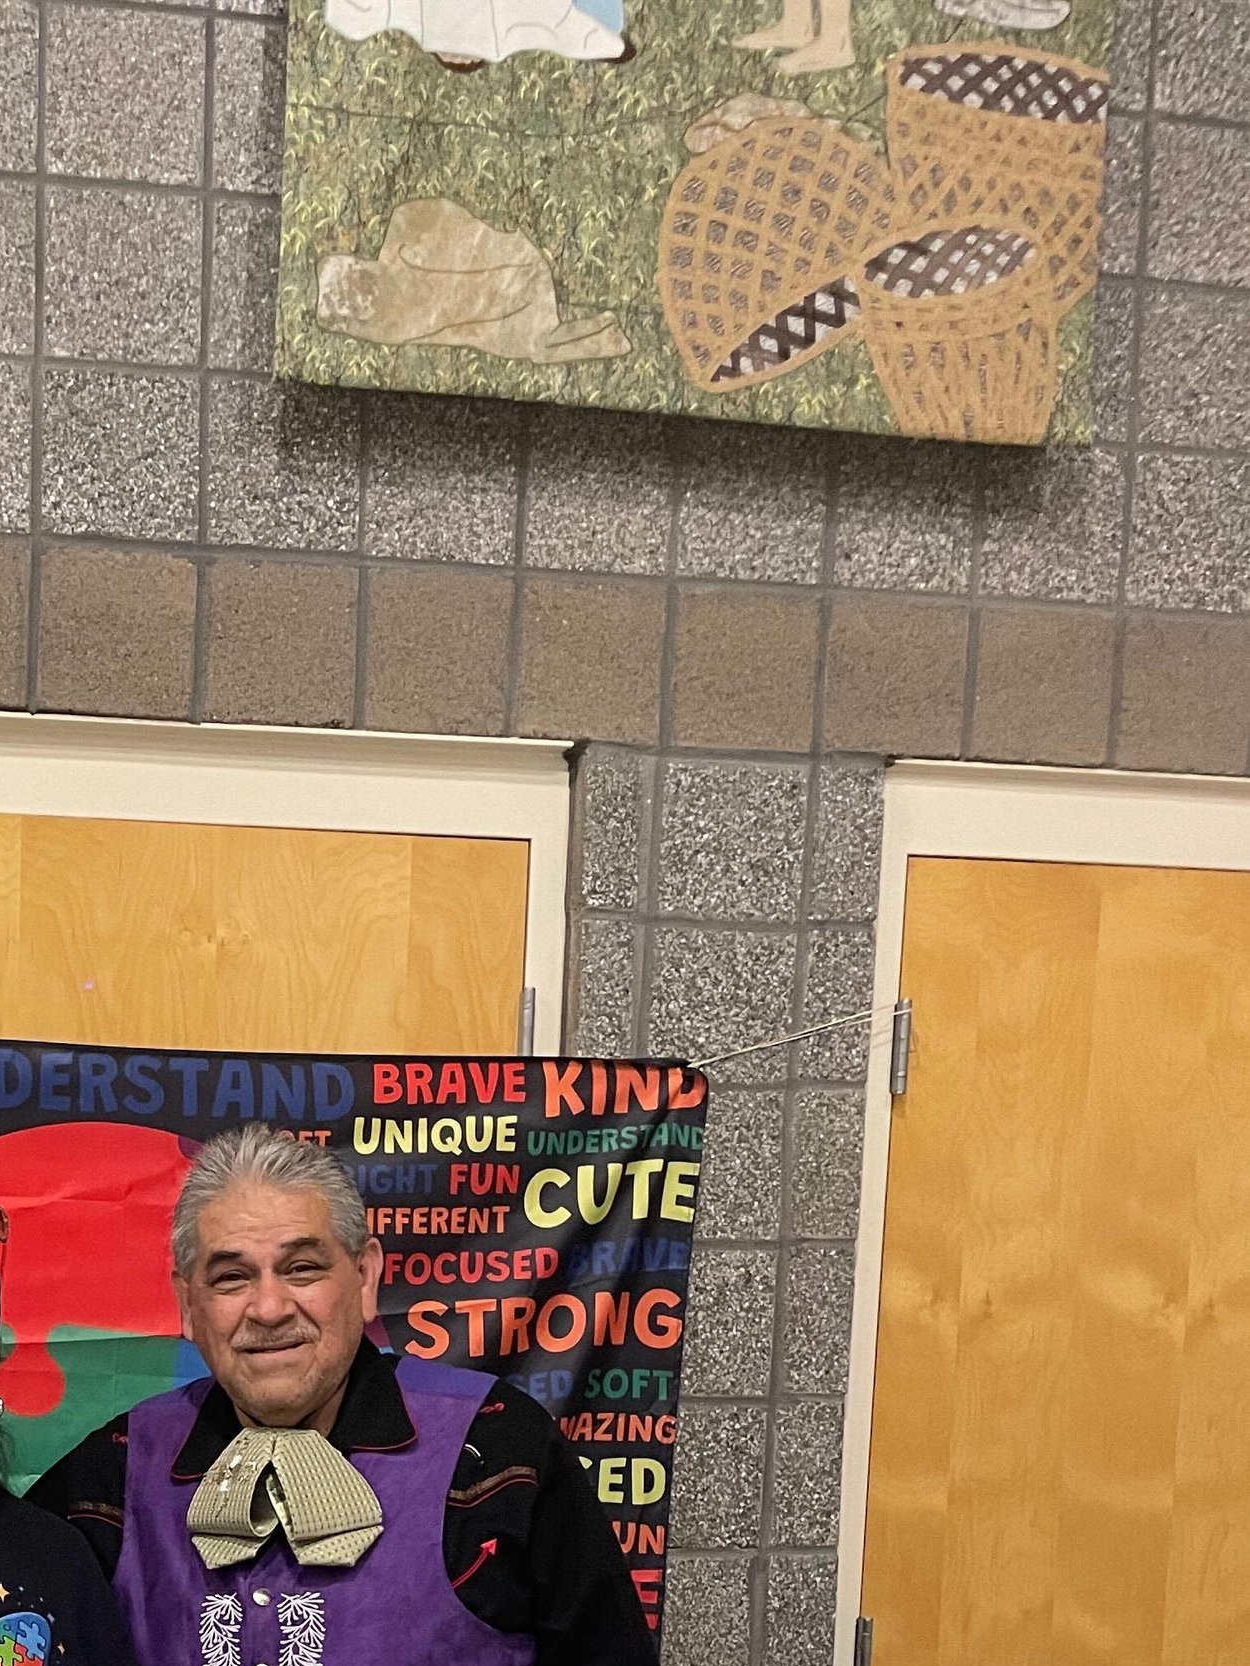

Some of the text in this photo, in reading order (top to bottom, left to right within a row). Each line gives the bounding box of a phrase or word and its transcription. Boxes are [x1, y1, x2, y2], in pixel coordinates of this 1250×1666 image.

[372, 1062, 527, 1105] BRAVE
[352, 1115, 518, 1155] UNIQUE
[527, 1124, 704, 1157] UNDERSTAND
[353, 1163, 520, 1196] IGHT FUN
[523, 1159, 701, 1229] CUTE
[366, 1206, 510, 1236] IFFERENT
[384, 1247, 559, 1286] FOCUSED
[404, 1288, 682, 1361] STRONG
[583, 1368, 674, 1401] SOFT
[560, 1411, 677, 1445] AZING
[612, 1521, 665, 1554] UN
